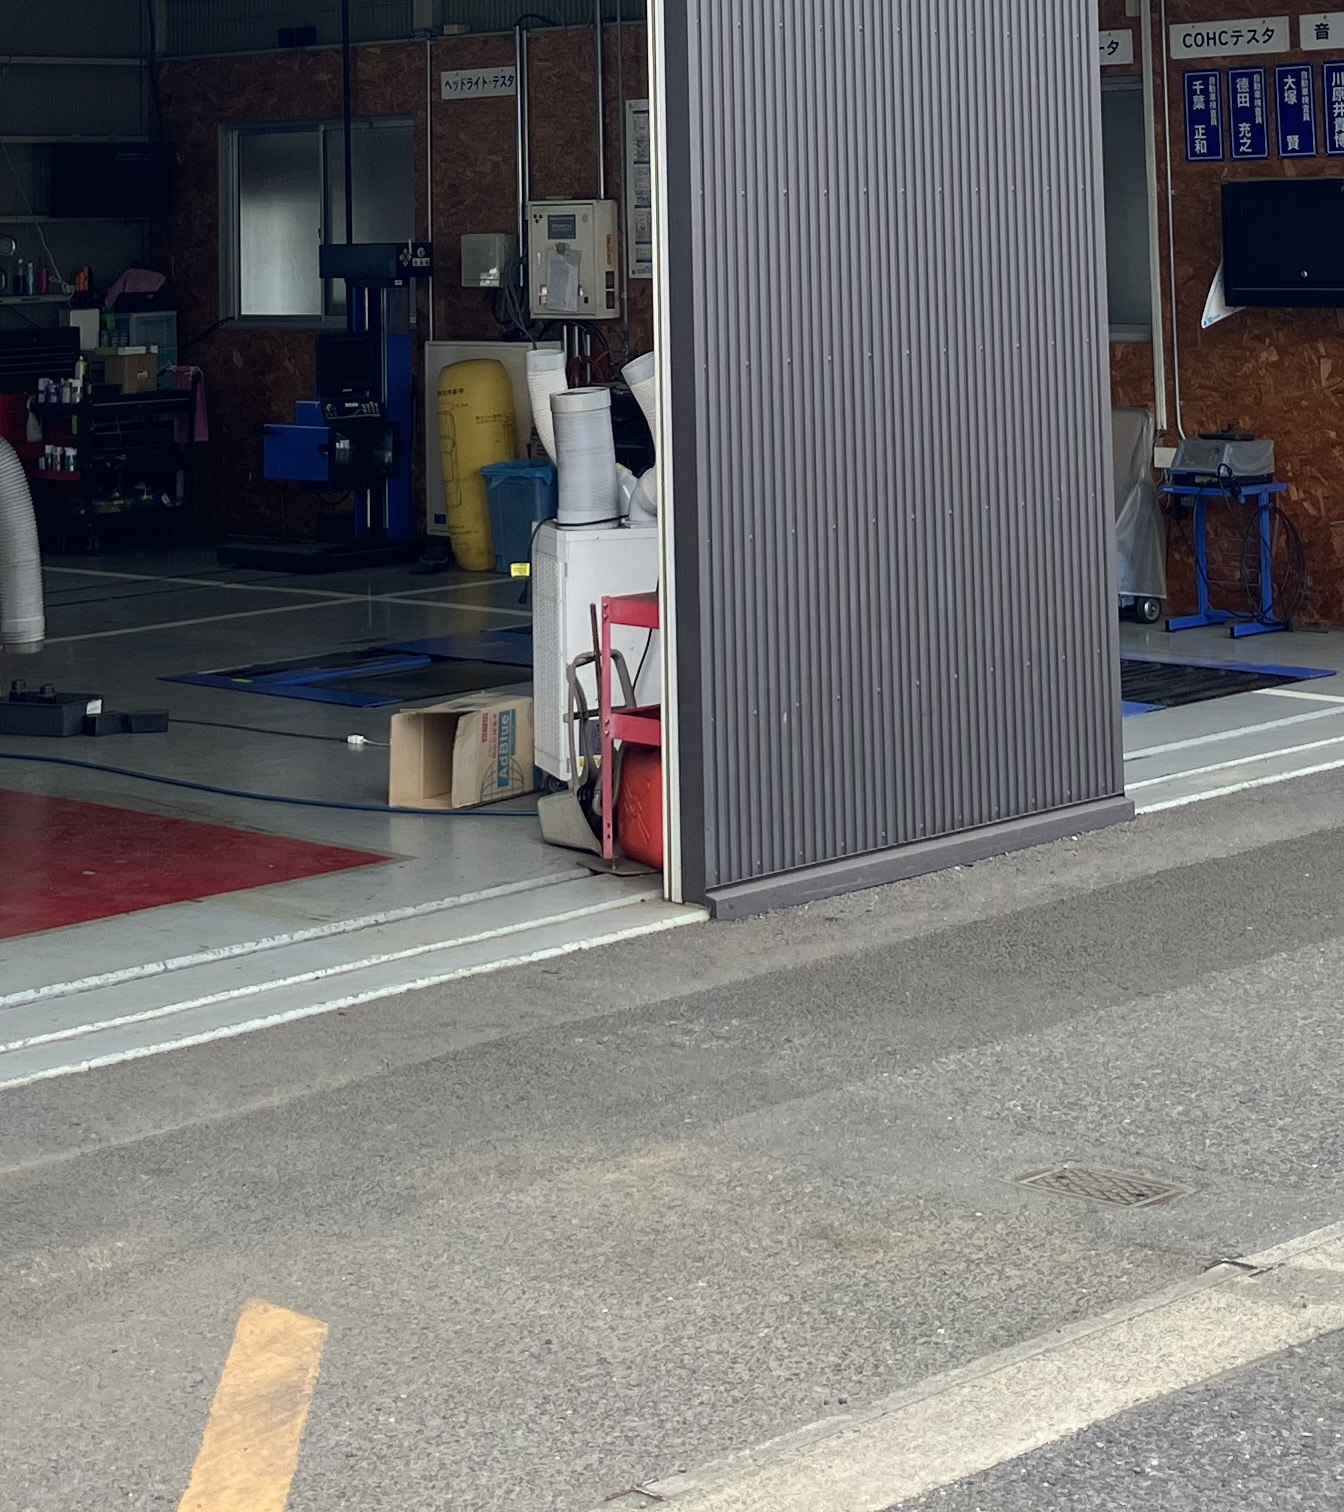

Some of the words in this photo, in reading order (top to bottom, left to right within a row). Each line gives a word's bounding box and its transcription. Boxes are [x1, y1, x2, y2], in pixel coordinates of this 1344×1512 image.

[1182, 27, 1275, 48] COHCテスタ
[498, 713, 511, 778] AdBlue
